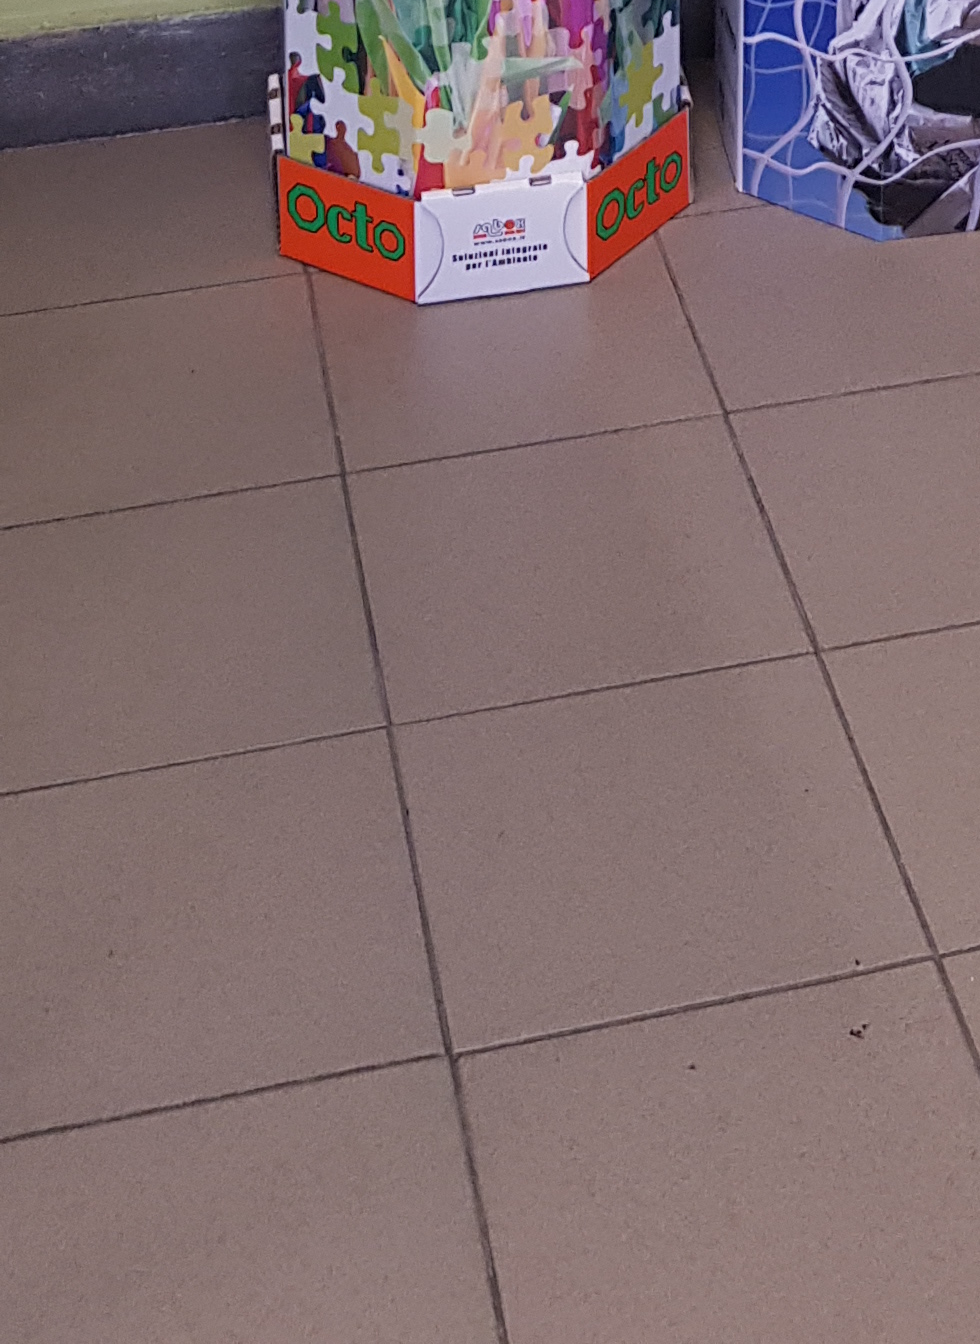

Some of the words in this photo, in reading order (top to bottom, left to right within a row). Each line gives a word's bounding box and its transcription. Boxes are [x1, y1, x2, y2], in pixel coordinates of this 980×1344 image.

[596, 151, 683, 241] Octo
[287, 182, 406, 261] Octo
[452, 249, 498, 262] Soluzioni
[466, 262, 482, 270] per
